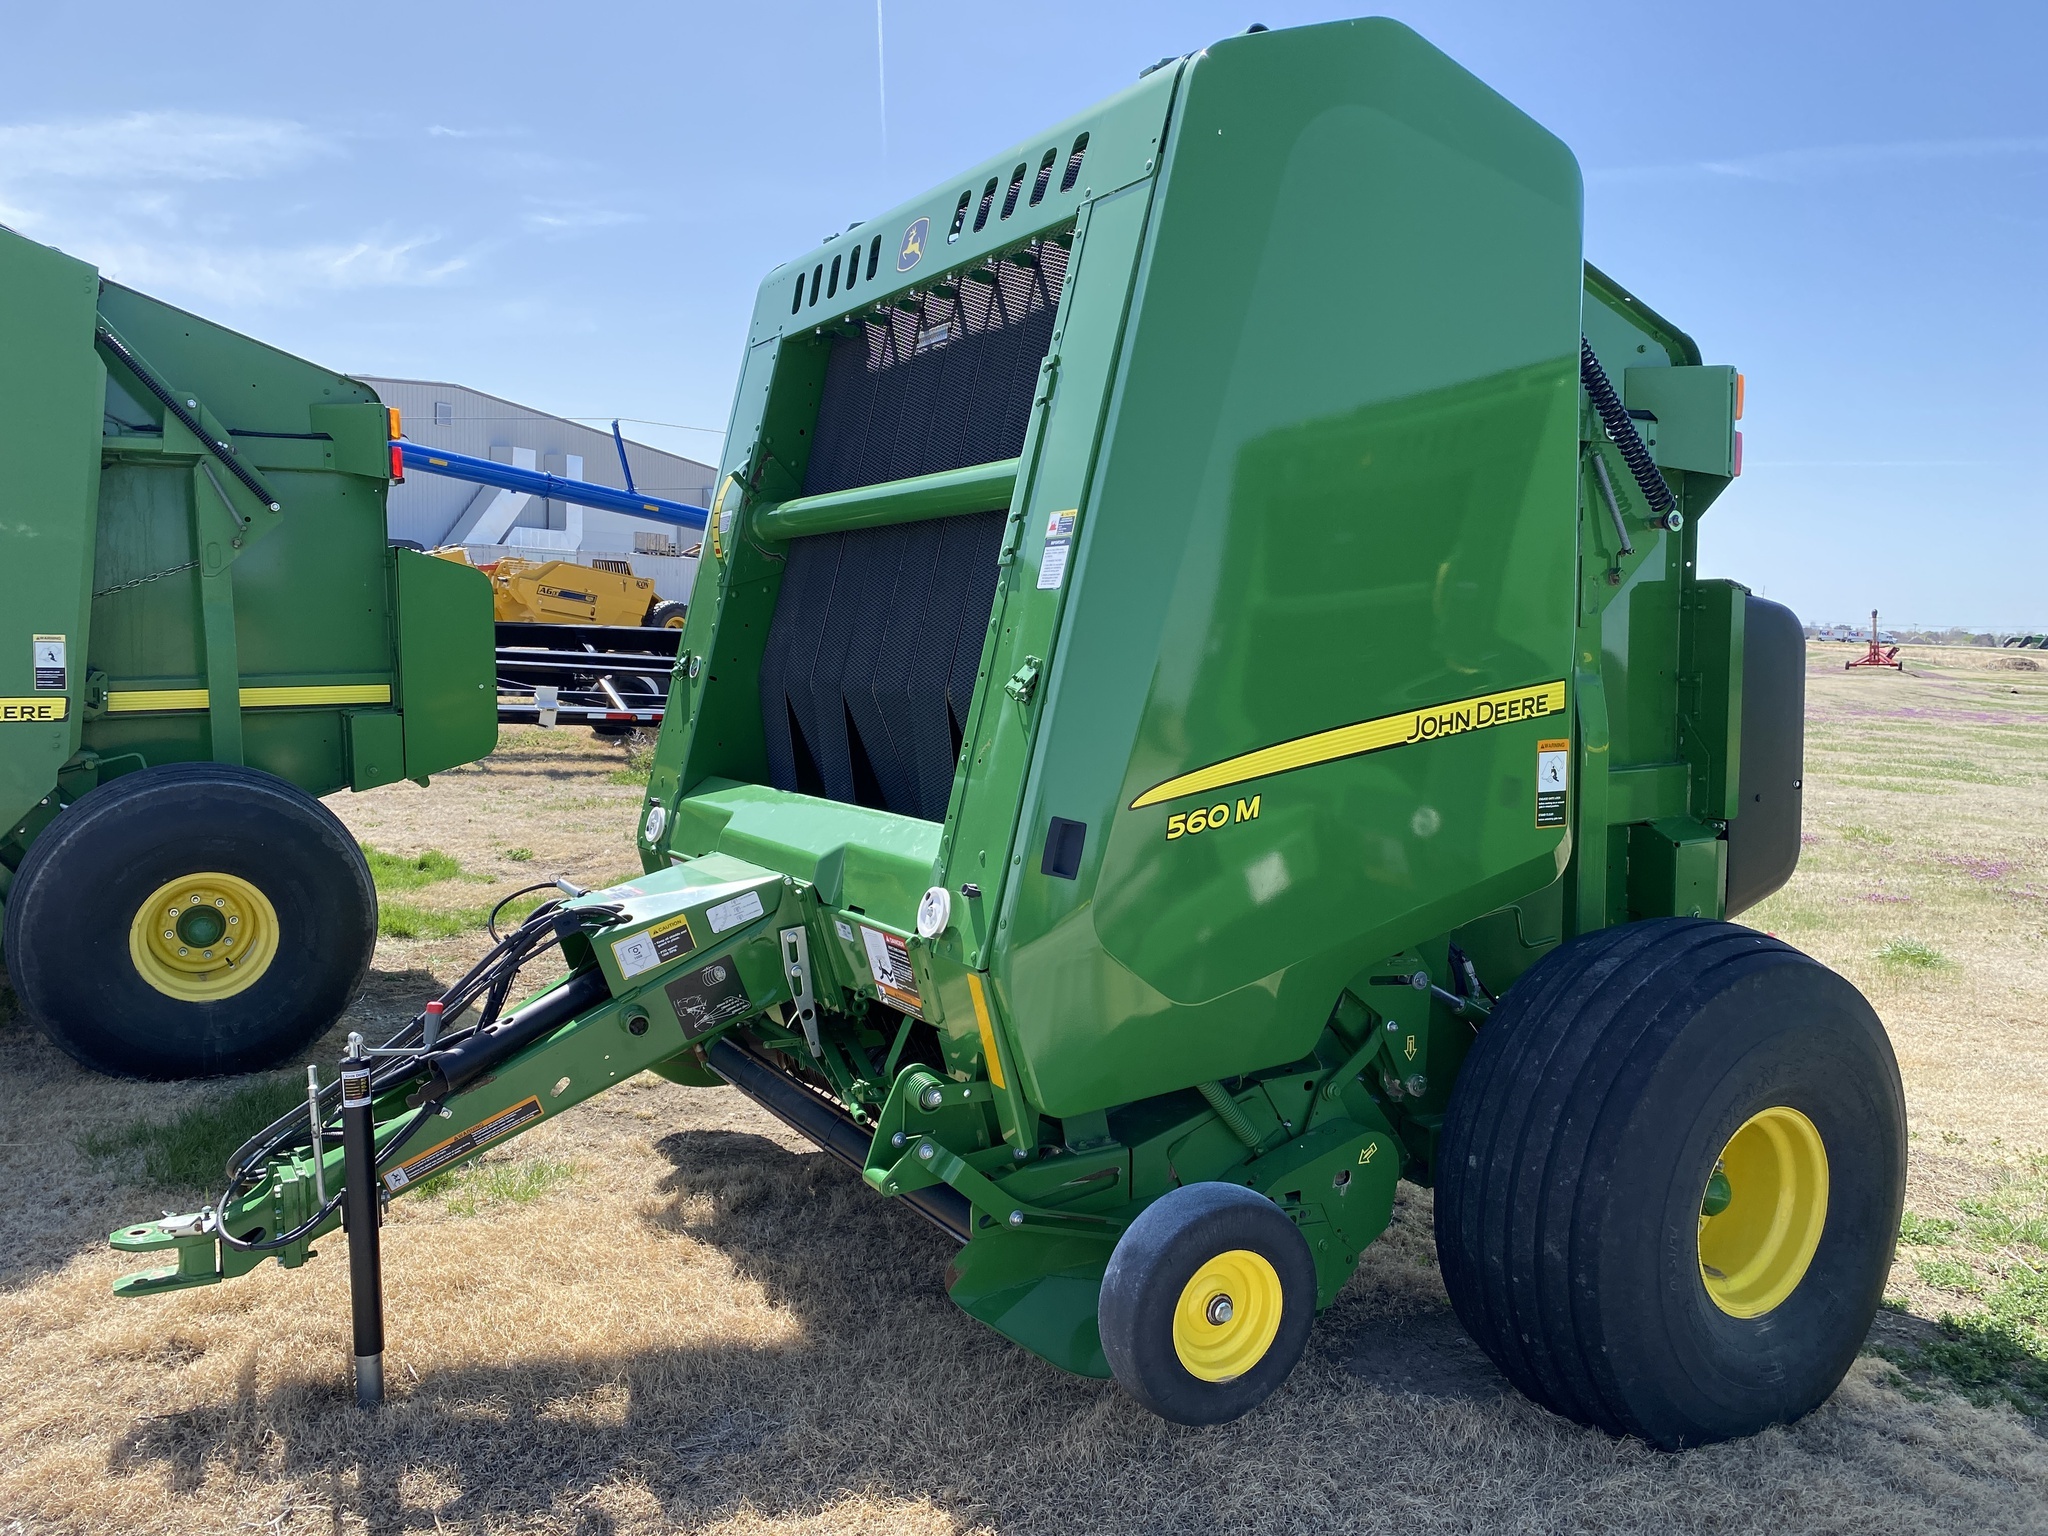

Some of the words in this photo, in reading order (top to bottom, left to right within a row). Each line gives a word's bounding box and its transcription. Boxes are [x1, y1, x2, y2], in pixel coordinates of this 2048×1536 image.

[0, 706, 52, 719] ERE
[1406, 709, 1471, 741] JOHN
[1476, 694, 1549, 726] DEERE
[1165, 803, 1231, 841] 560
[1234, 793, 1262, 825] M
[658, 920, 682, 932] CAUTION
[457, 1122, 485, 1139] WARNING
